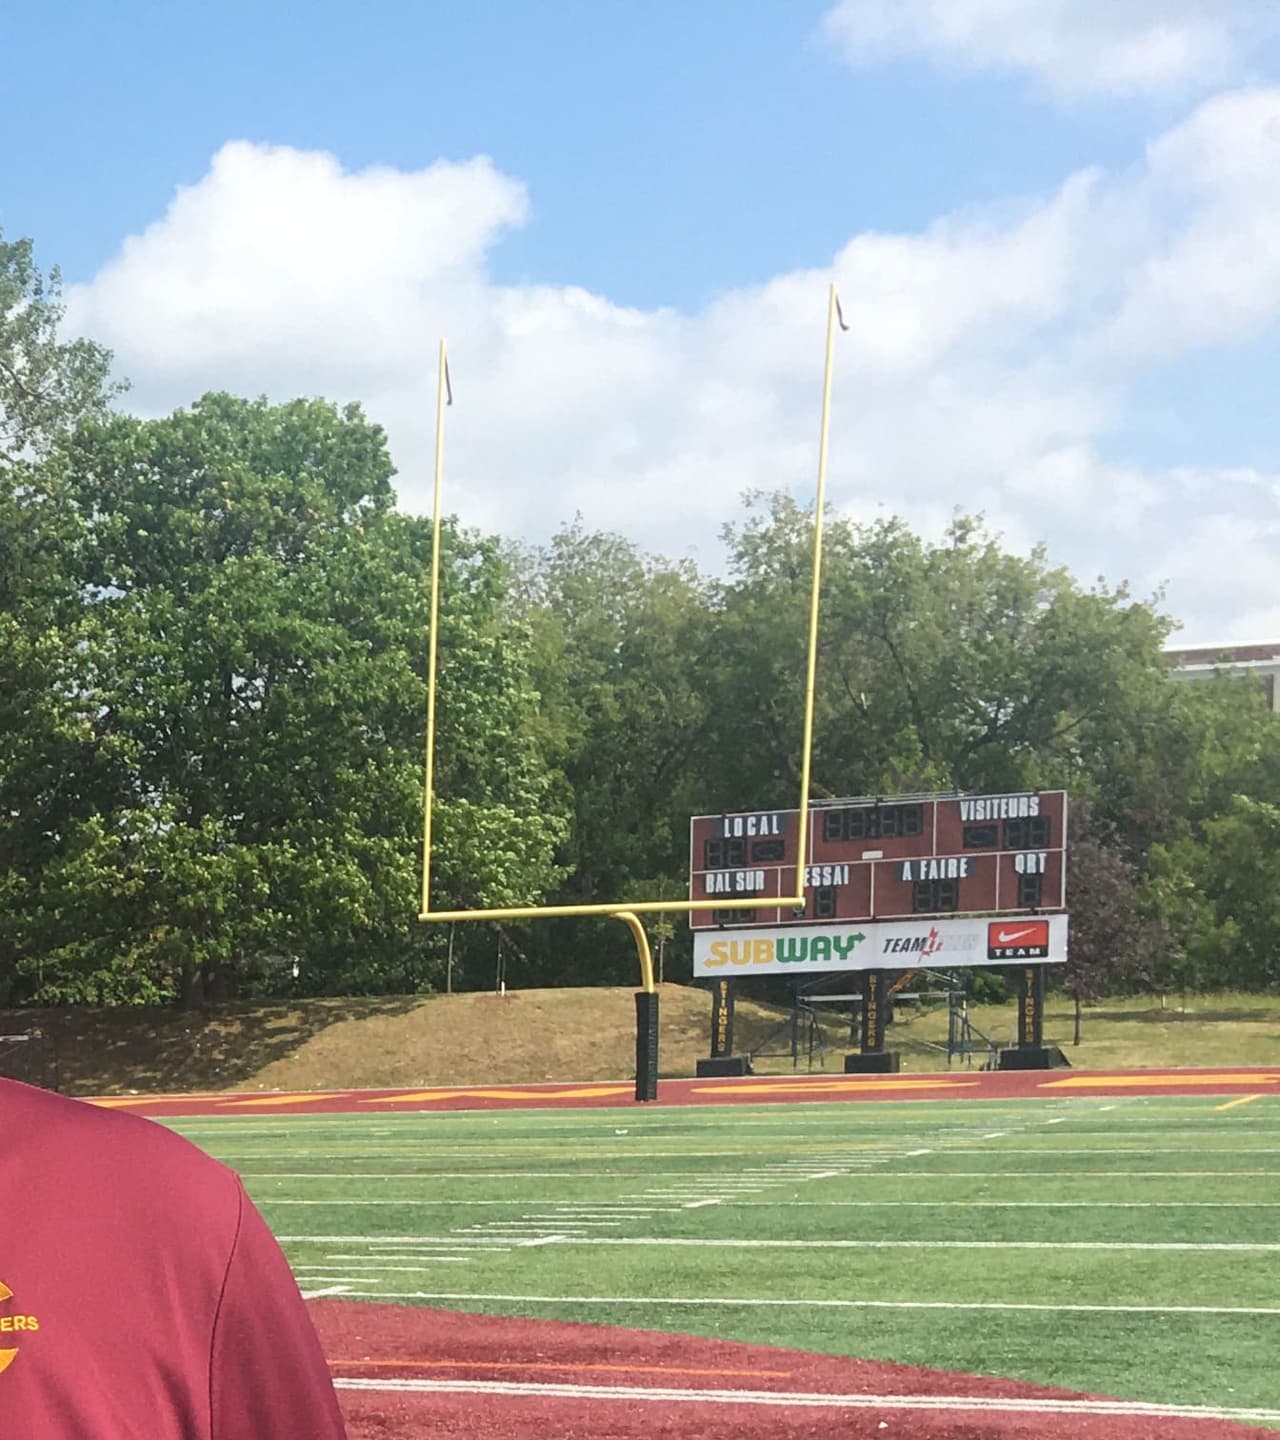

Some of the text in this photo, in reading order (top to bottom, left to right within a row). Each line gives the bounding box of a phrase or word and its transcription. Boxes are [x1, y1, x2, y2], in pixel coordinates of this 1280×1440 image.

[959, 796, 1040, 821] VISITEURS
[723, 815, 780, 838] LOCAL
[919, 857, 968, 880] FAIRE
[1014, 853, 1047, 875] QRT
[705, 870, 765, 893] BAL SUR
[803, 865, 849, 887] ESSAI
[703, 932, 866, 968] SUBWAY
[994, 947, 1041, 957] TEAM
